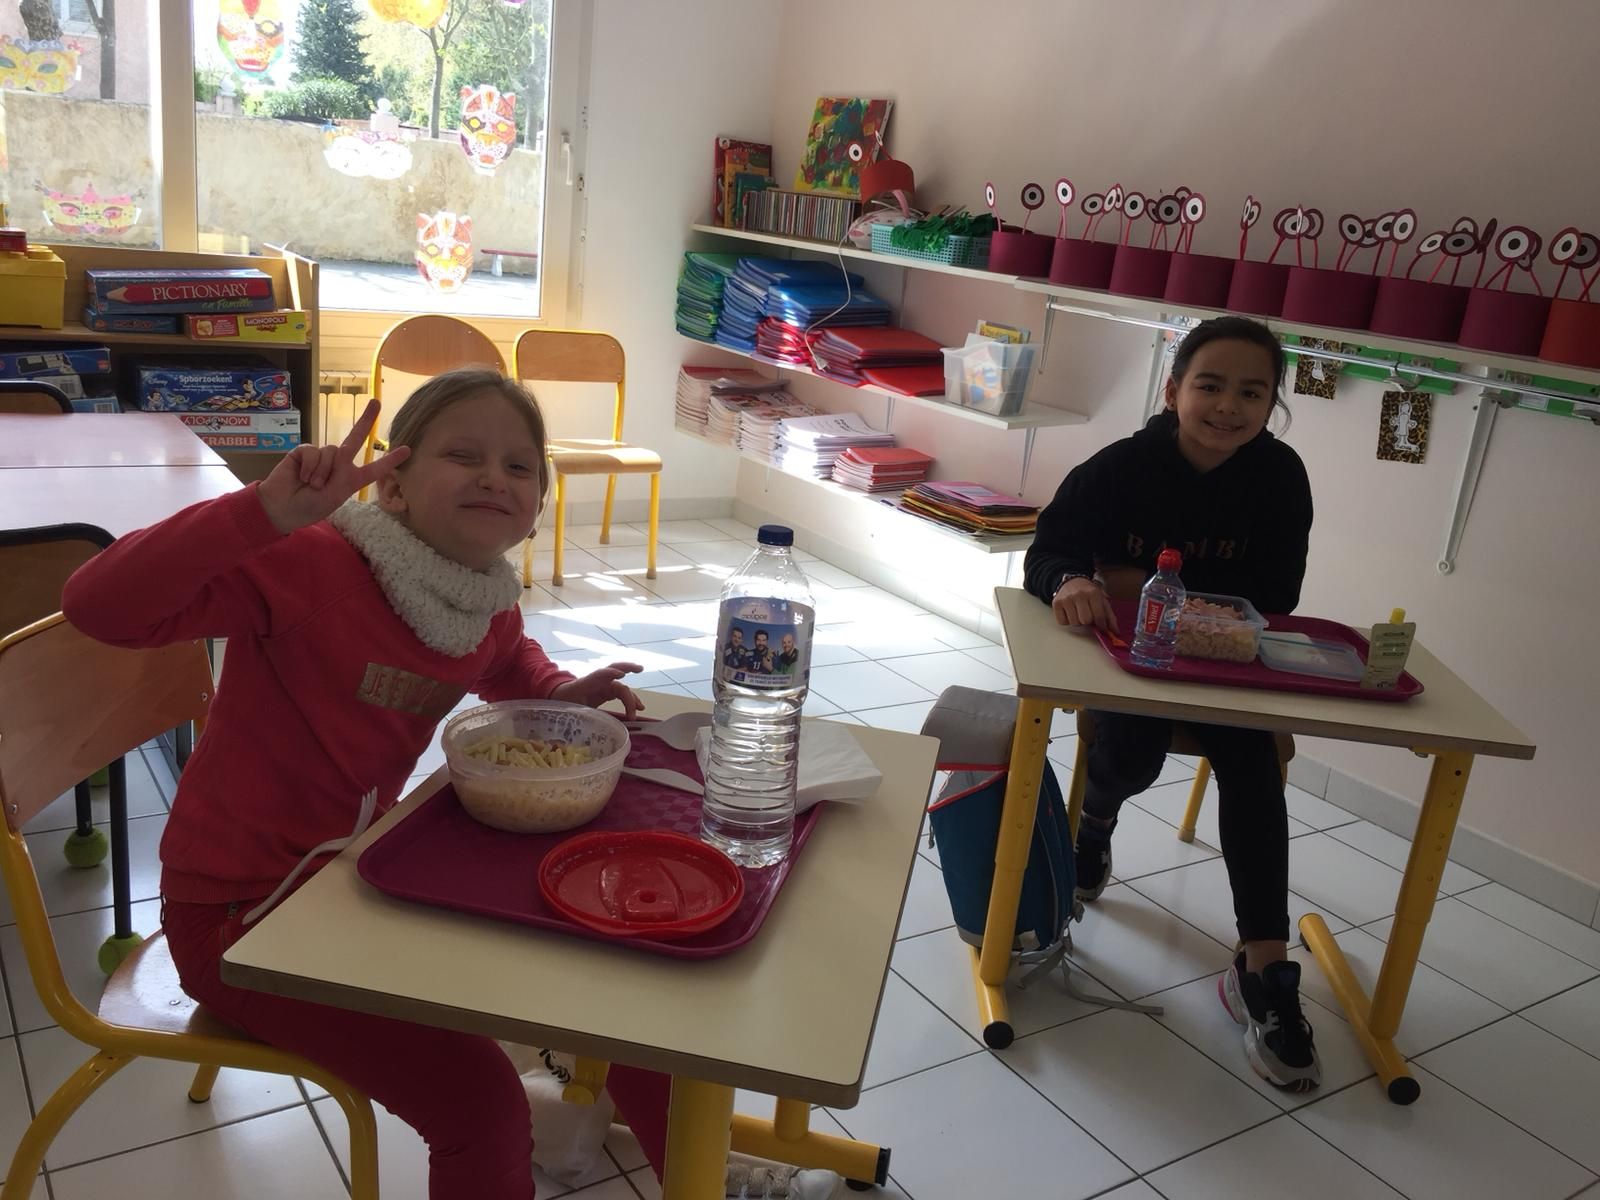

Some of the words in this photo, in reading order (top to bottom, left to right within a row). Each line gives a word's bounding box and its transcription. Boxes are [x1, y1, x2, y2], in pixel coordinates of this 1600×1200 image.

[152, 283, 249, 300] PICTIONARY
[246, 317, 286, 325] MONOPOLY
[201, 436, 257, 446] RABBLE
[1128, 533, 1249, 559] BMBI
